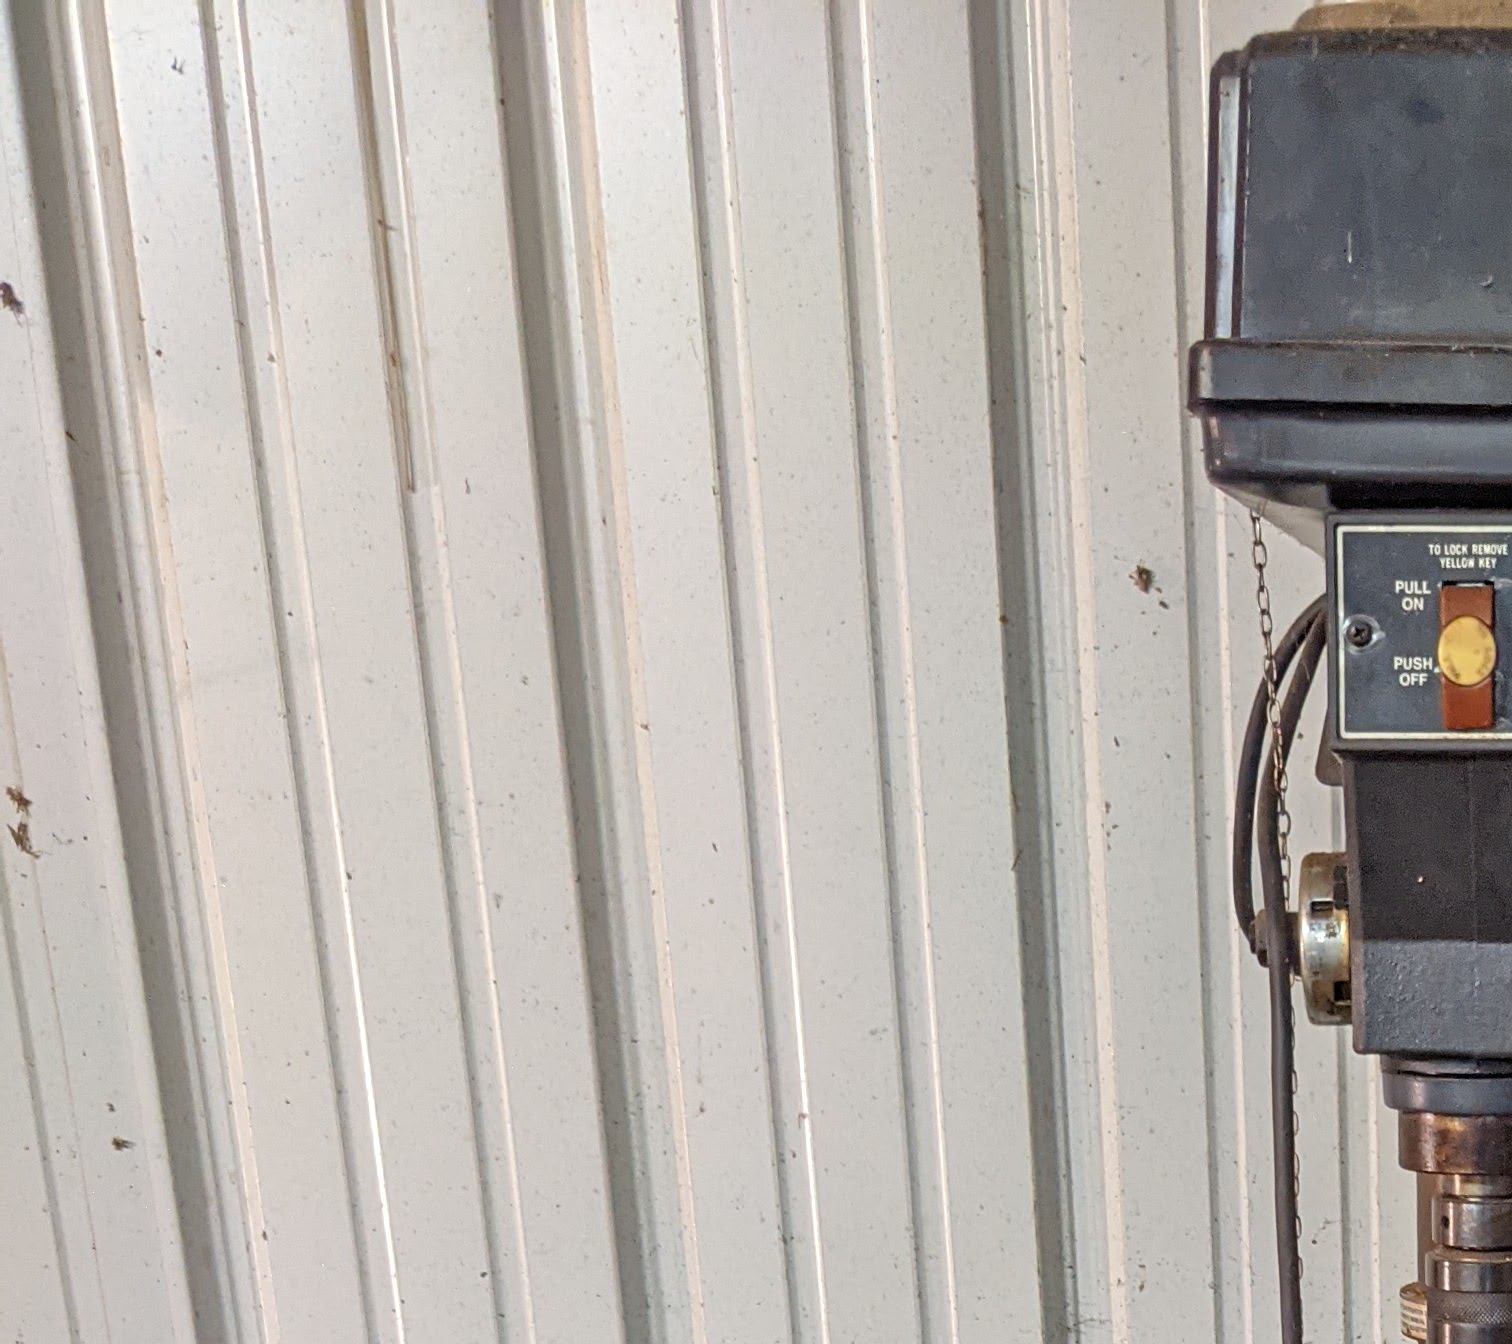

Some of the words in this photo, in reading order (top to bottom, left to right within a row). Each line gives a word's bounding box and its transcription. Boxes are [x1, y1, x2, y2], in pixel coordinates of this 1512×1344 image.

[1428, 543, 1441, 555] TO
[1444, 543, 1468, 555] LOCK
[1471, 543, 1508, 555] REMOVE
[1439, 557, 1475, 569] YELLOW
[1478, 557, 1497, 569] KEY
[1395, 580, 1431, 595] PULL
[1401, 596, 1424, 611] ON
[1393, 656, 1433, 671] PUSH
[1399, 672, 1428, 687] OFF
